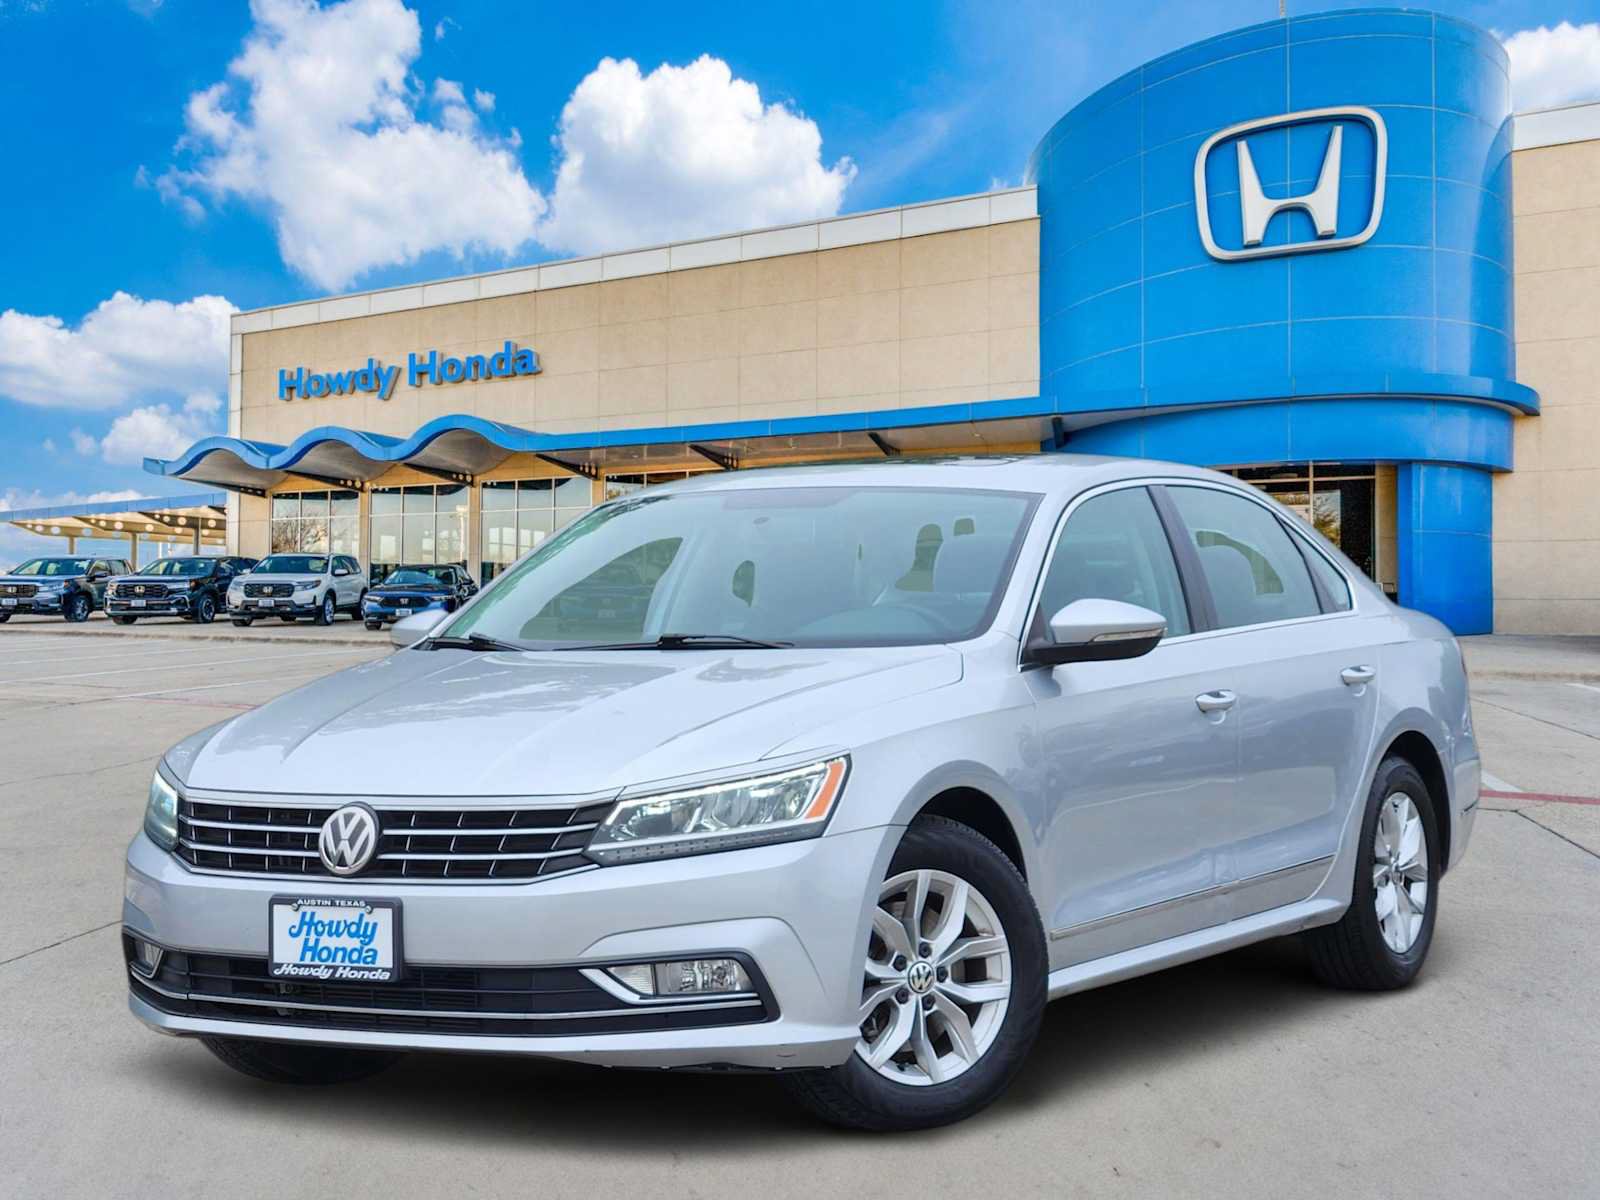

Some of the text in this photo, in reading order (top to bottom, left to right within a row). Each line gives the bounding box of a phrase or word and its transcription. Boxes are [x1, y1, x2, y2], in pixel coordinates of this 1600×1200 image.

[278, 340, 541, 400] Howdy Honda
[288, 911, 378, 945] Howdy
[300, 938, 378, 965] Honda
[273, 964, 391, 980] Howdy Honda
